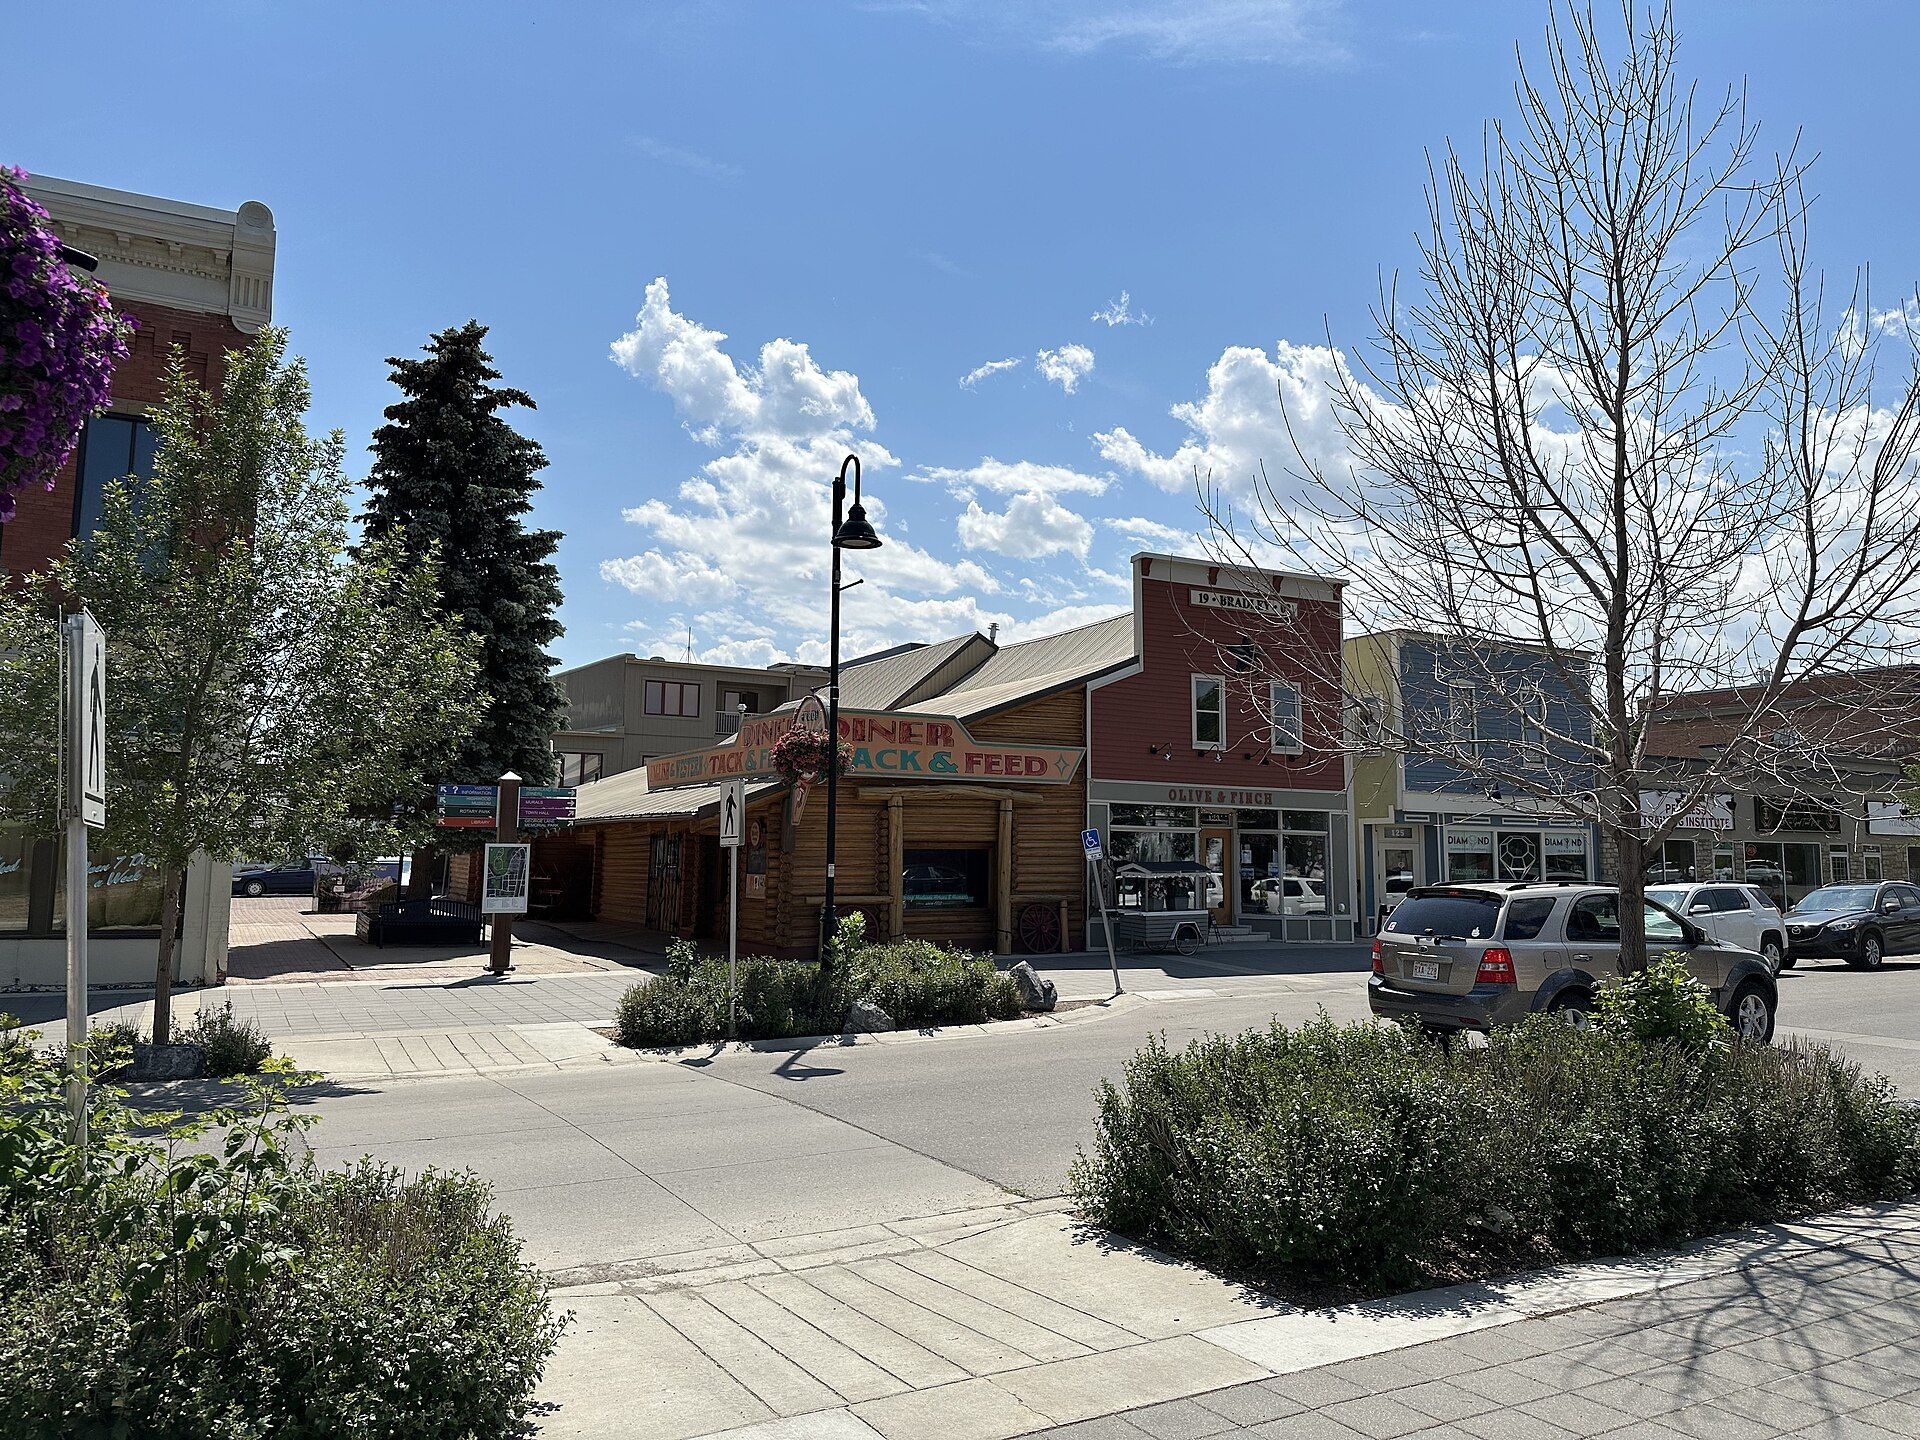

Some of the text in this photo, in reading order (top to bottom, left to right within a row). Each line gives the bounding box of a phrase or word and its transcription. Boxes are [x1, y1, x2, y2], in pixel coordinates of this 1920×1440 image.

[1198, 592, 1210, 604] 19
[708, 751, 744, 775] TACK
[745, 749, 758, 772] &
[852, 747, 1048, 776] ACK & FEED
[1168, 789, 1273, 805] OLIVE & FINCH
[1686, 816, 1730, 828] INSTITUTE
[1391, 829, 1405, 837] 125
[113, 855, 127, 870] 7
[106, 868, 144, 886] Week
